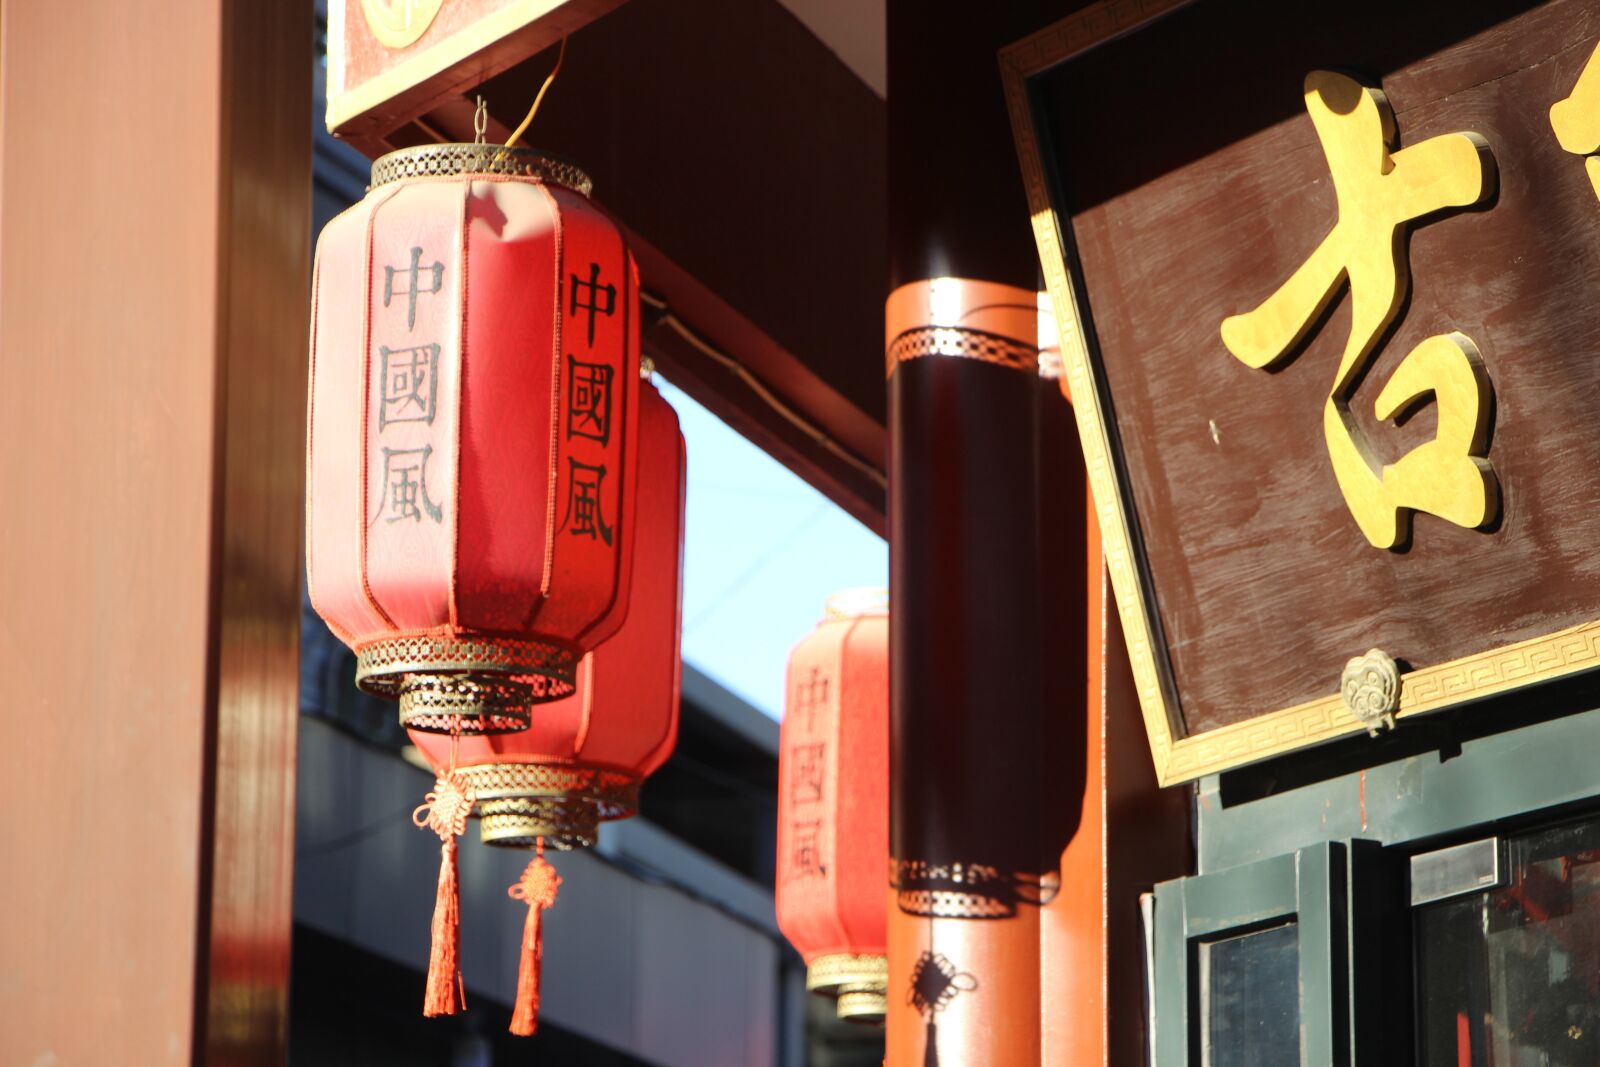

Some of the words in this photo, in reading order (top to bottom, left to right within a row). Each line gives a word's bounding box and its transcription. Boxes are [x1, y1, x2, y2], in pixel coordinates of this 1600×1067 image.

[372, 247, 445, 526] 中國風
[557, 263, 618, 547] 中國風
[1220, 40, 1600, 549] 古
